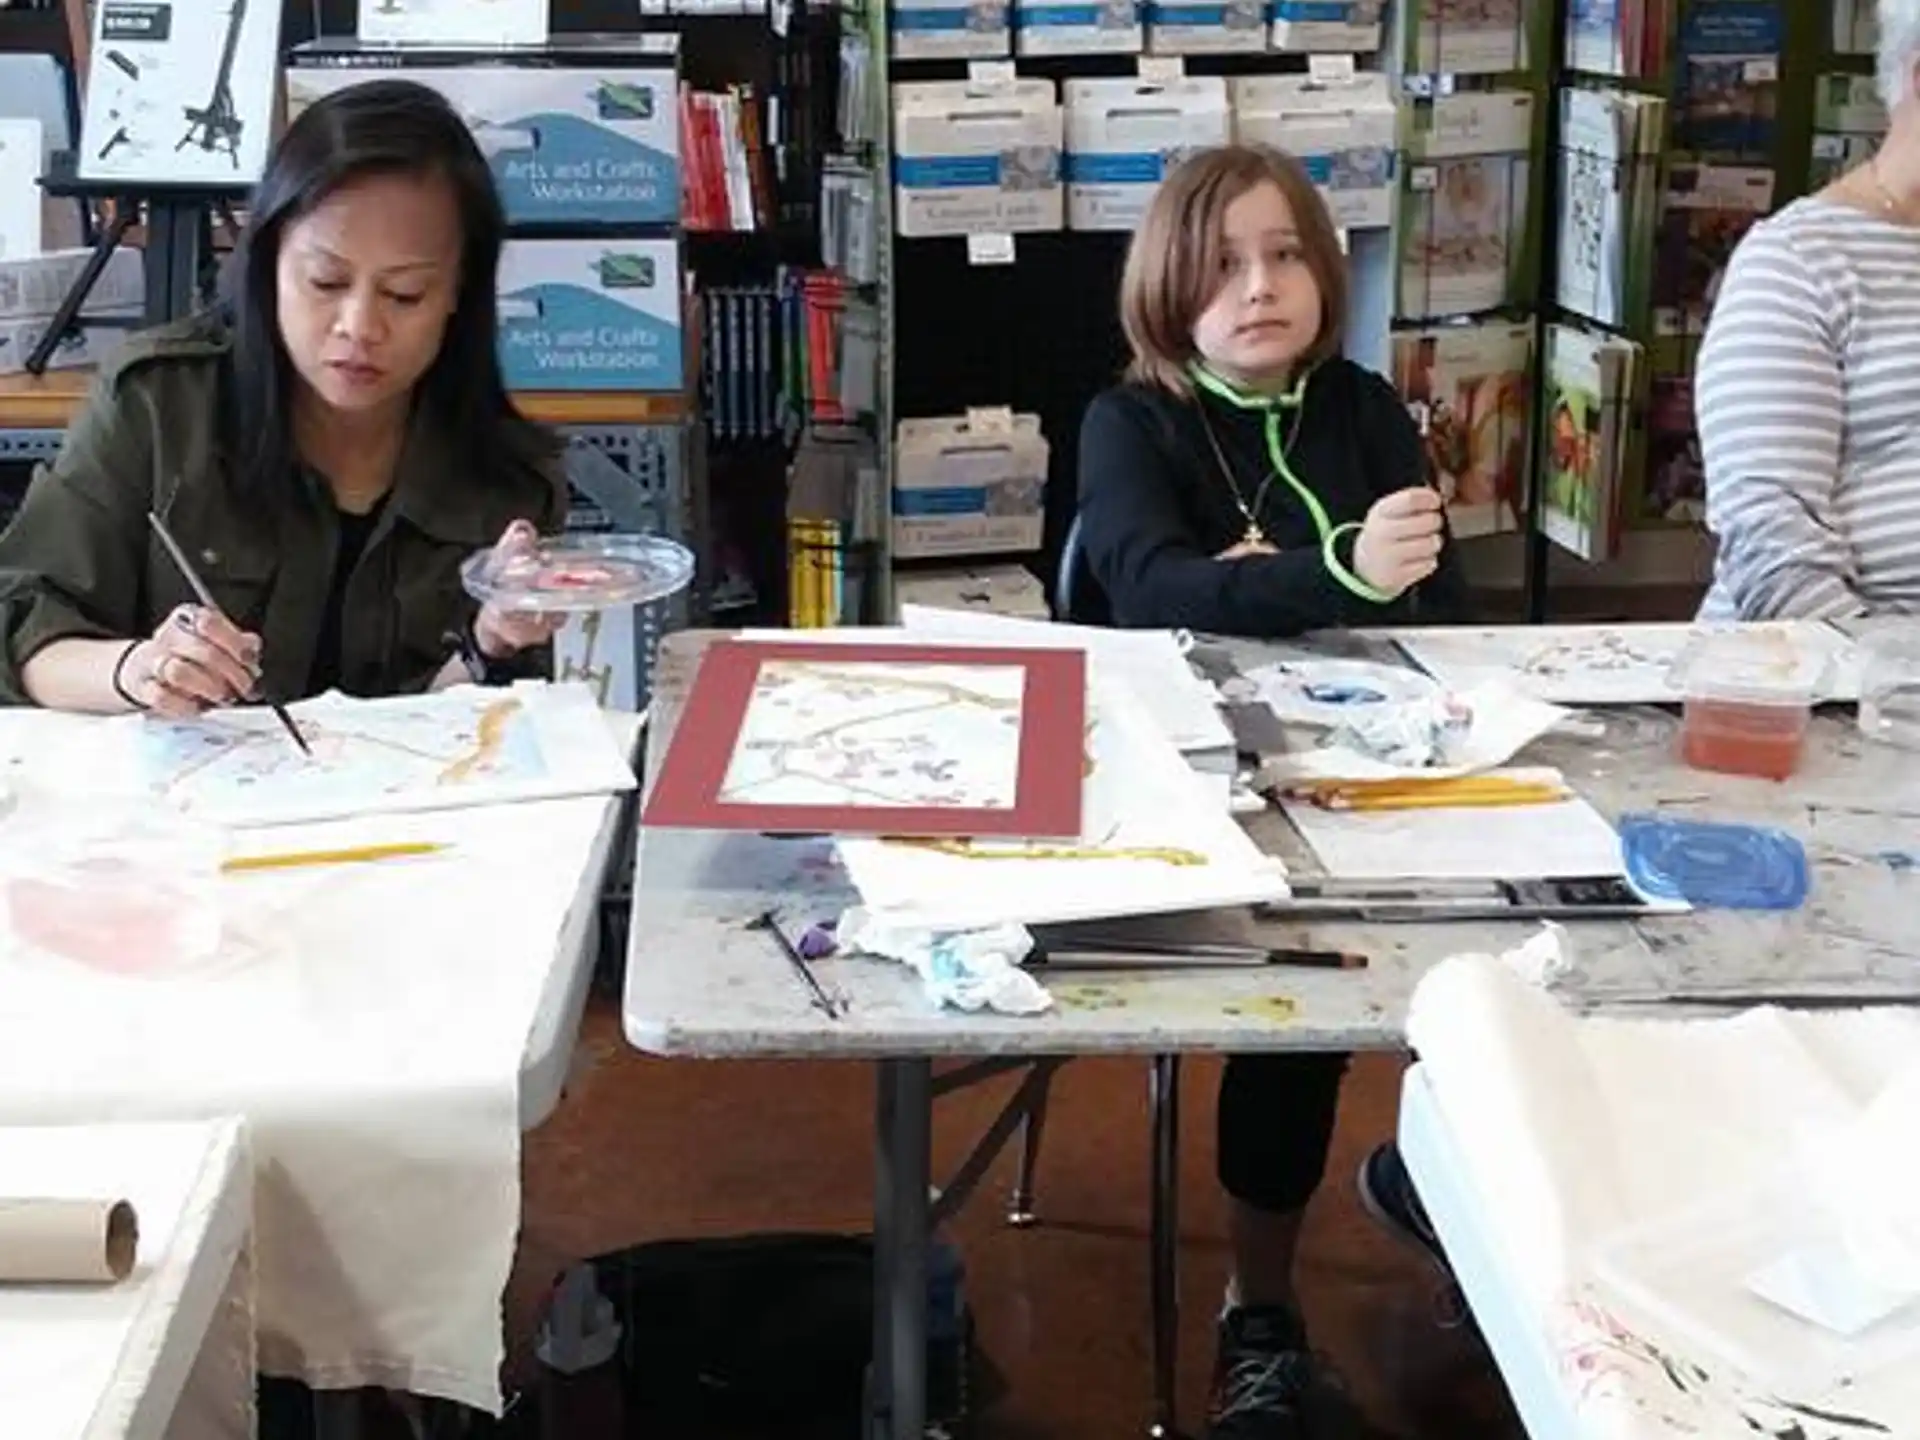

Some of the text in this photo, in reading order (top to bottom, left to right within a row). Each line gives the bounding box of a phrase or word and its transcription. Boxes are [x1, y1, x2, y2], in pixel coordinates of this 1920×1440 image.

[505, 157, 658, 180] Arts and Crafts
[531, 181, 657, 200] Workstation
[507, 325, 659, 347] Arts and Crafts
[534, 350, 660, 369] Workstation
